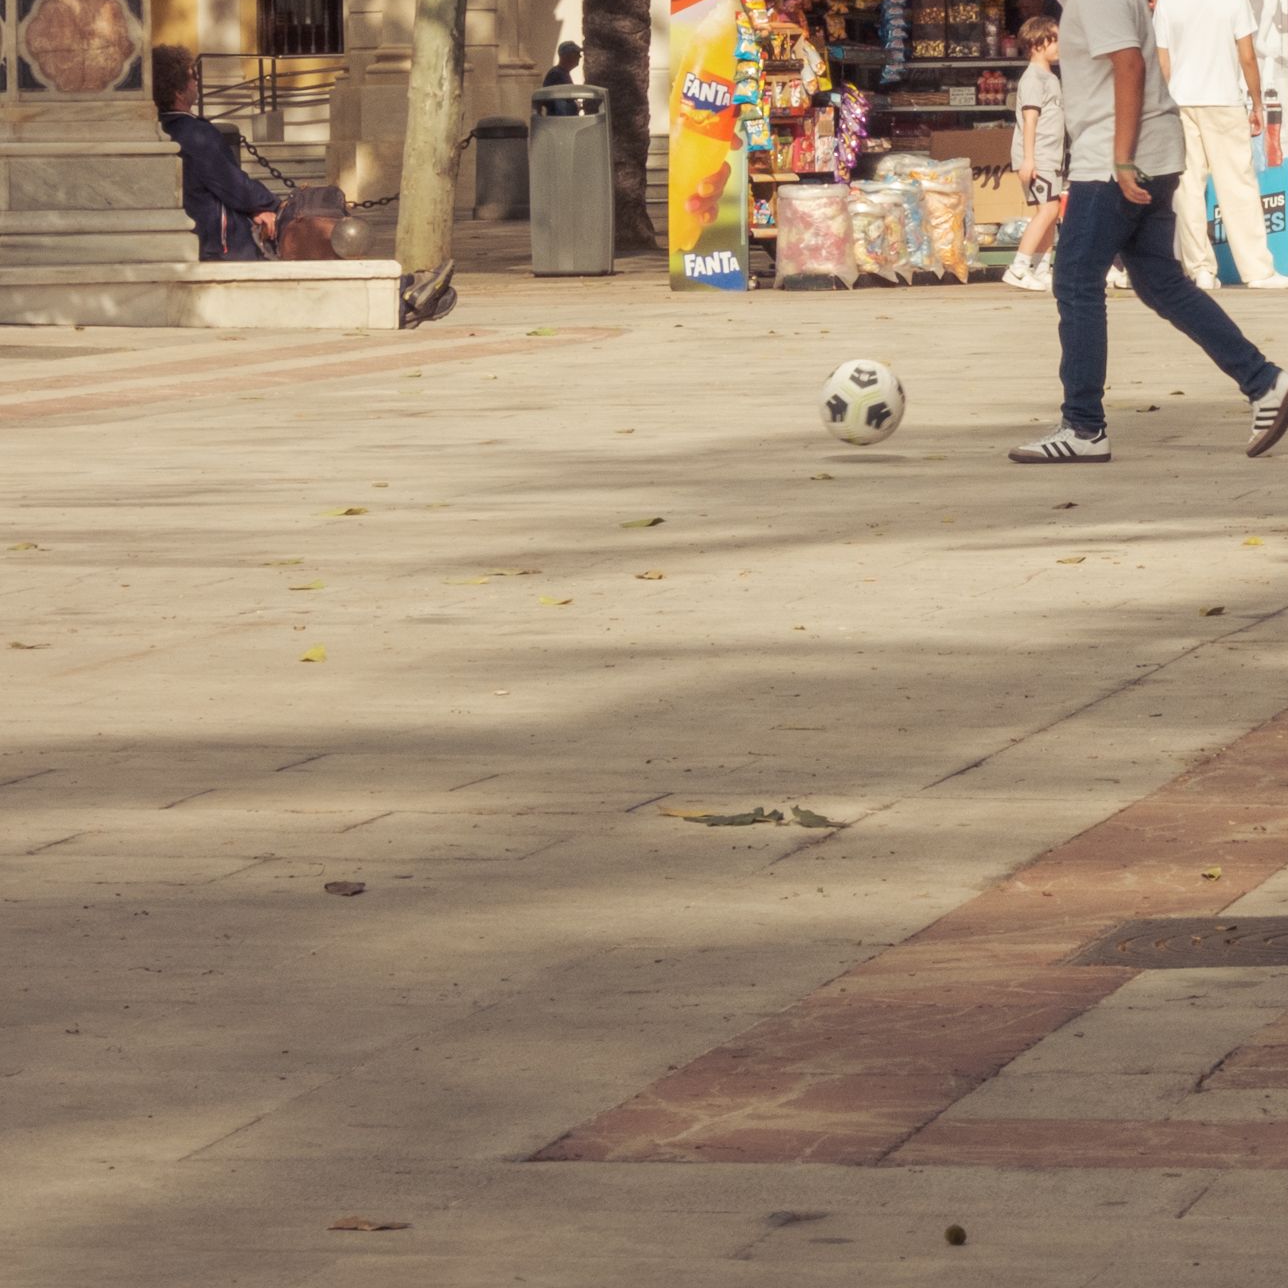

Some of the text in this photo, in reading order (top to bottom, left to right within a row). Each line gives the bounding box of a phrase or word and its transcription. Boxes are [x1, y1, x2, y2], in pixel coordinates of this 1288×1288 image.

[682, 72, 732, 107] FANTA
[1262, 194, 1285, 209] TUS
[684, 251, 740, 278] FANTA
